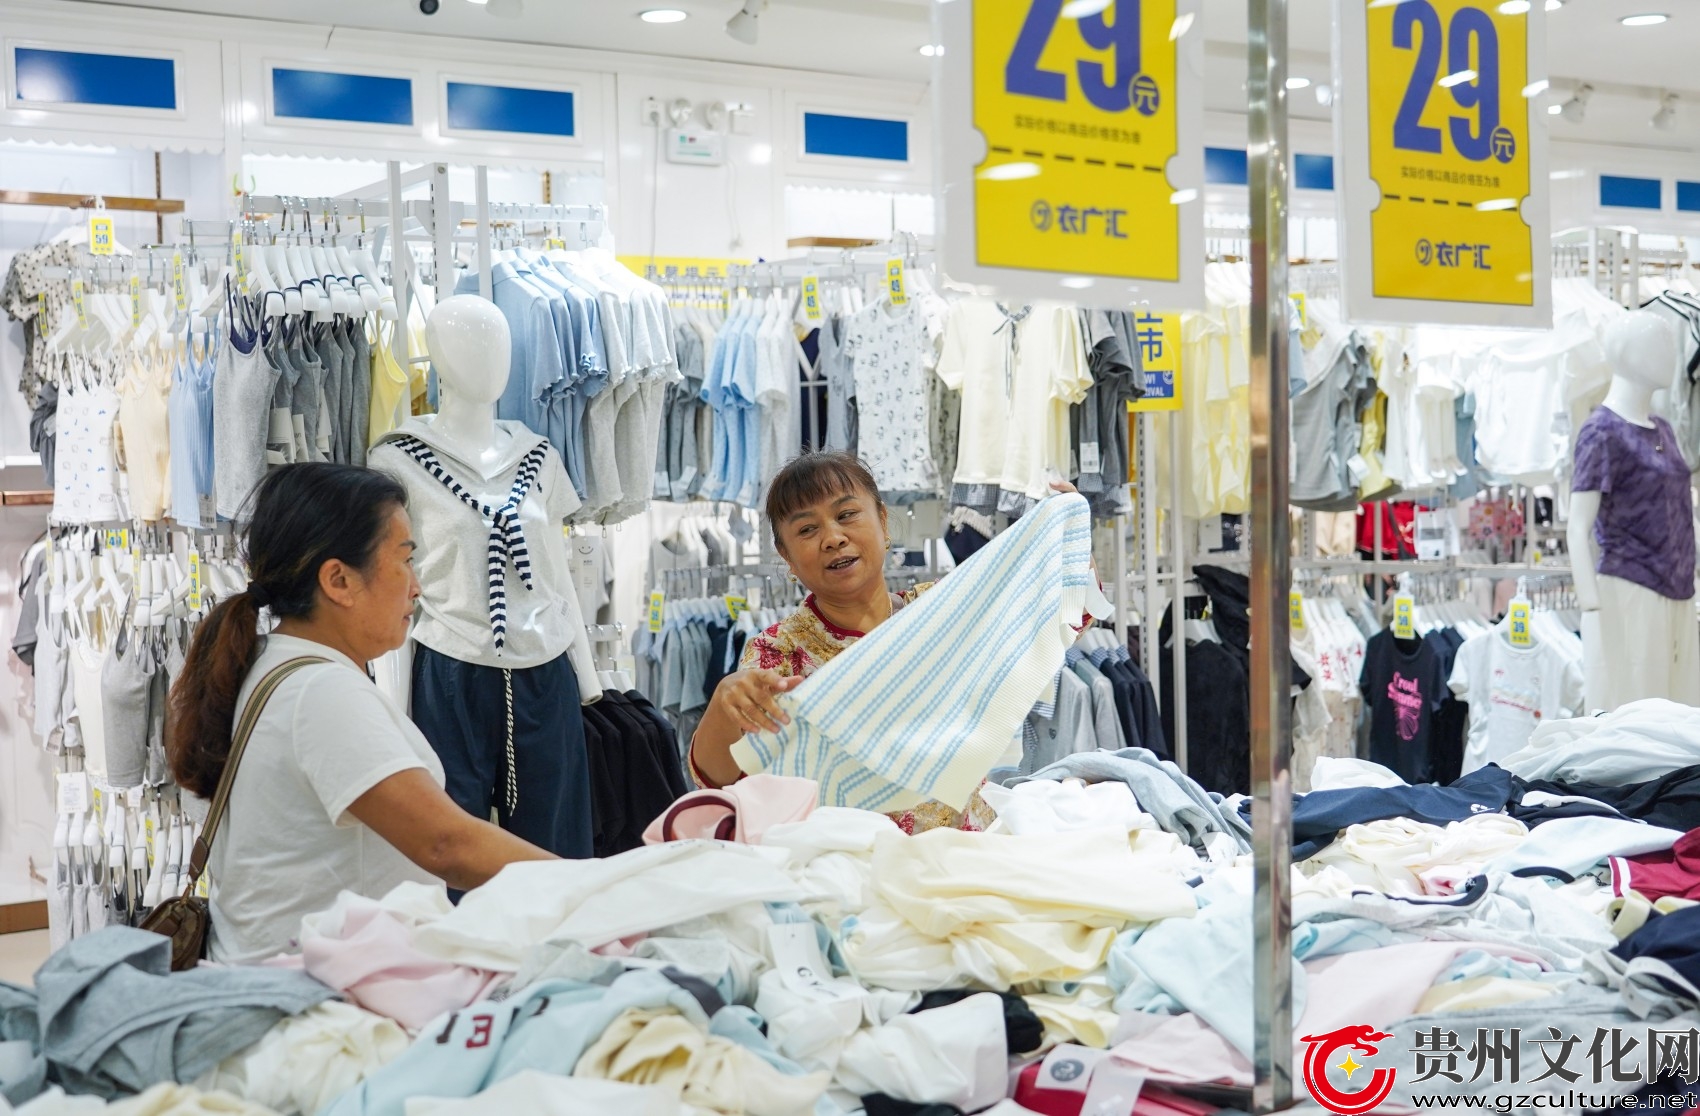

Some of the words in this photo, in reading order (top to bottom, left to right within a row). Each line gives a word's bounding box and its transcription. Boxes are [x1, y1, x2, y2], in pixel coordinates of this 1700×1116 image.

[1133, 79, 1158, 113] 元
[1392, 0, 1499, 161] 29
[1494, 131, 1513, 160] 元
[1056, 205, 1128, 238] 衣广汇
[1436, 242, 1491, 270] 衣广汇
